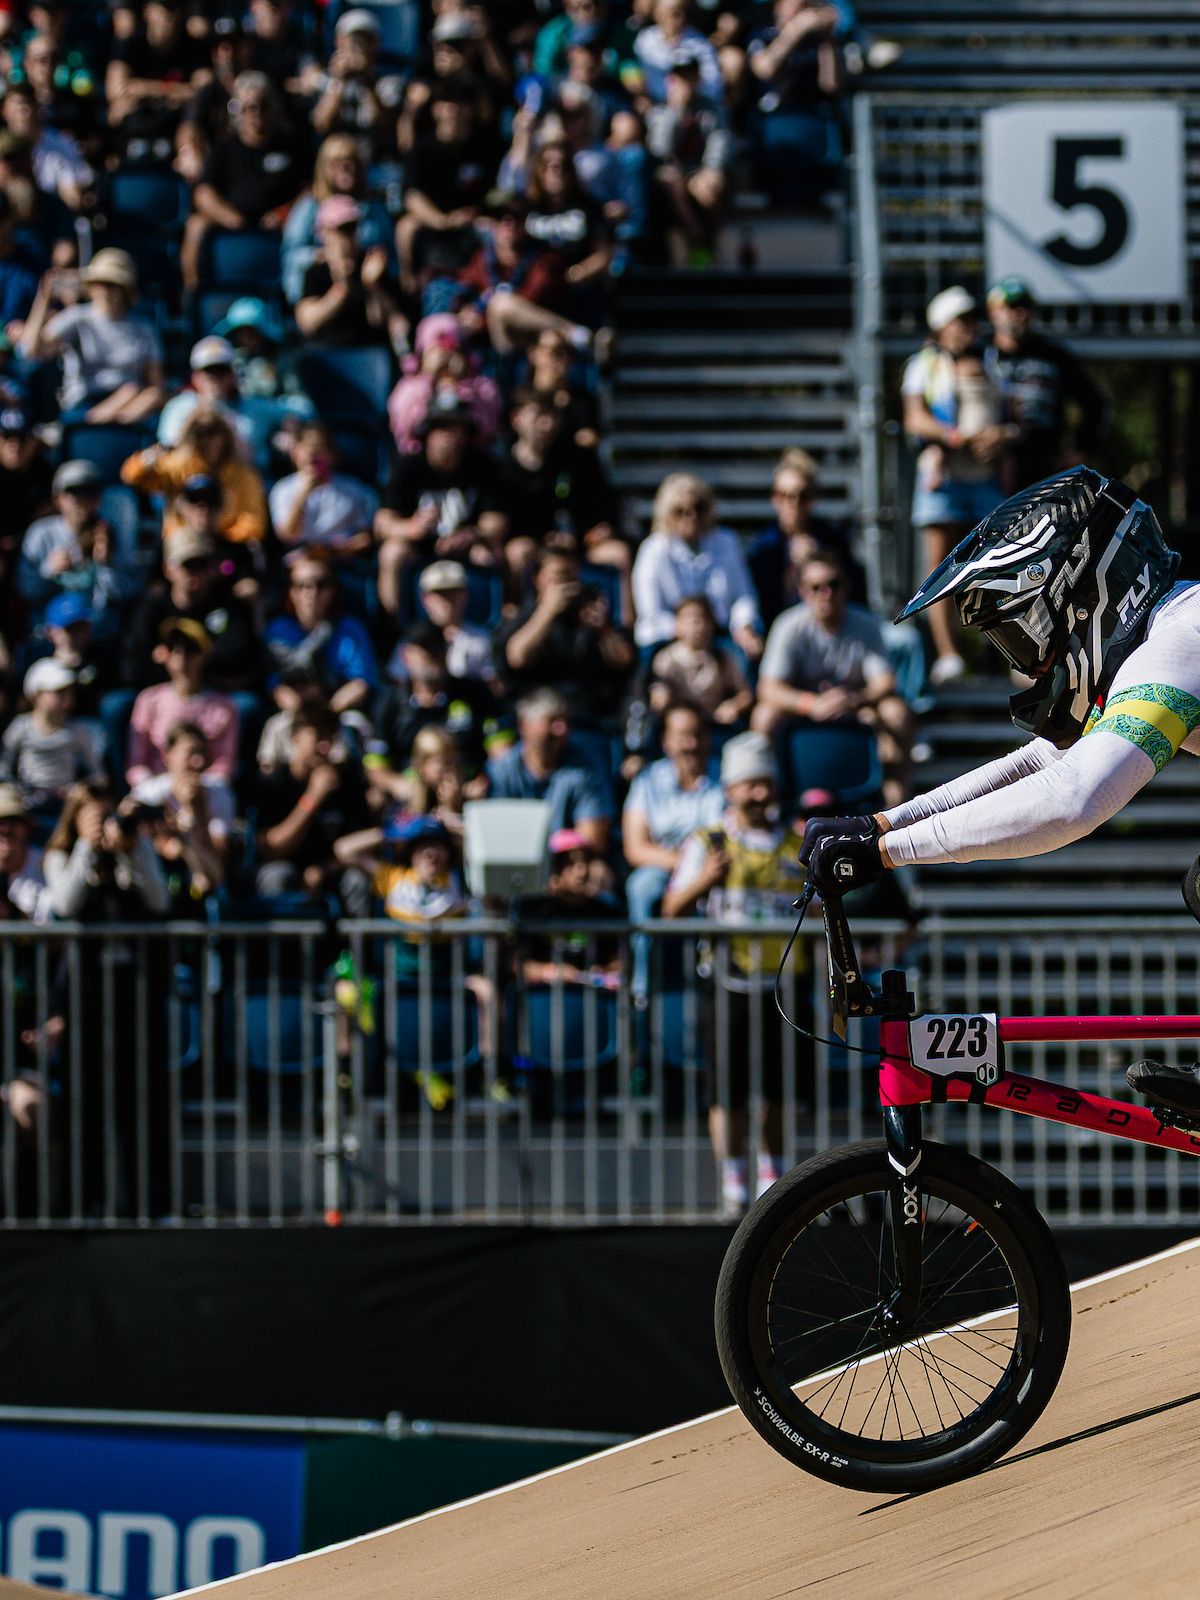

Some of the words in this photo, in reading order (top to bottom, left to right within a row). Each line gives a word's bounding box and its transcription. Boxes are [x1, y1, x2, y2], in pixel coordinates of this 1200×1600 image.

[1044, 137, 1130, 267] 5
[1049, 526, 1090, 612] FLY
[1116, 562, 1150, 625] FLY
[926, 1017, 988, 1060] 223
[757, 1396, 805, 1447] SCHWALBE
[803, 1442, 830, 1462] SX-R
